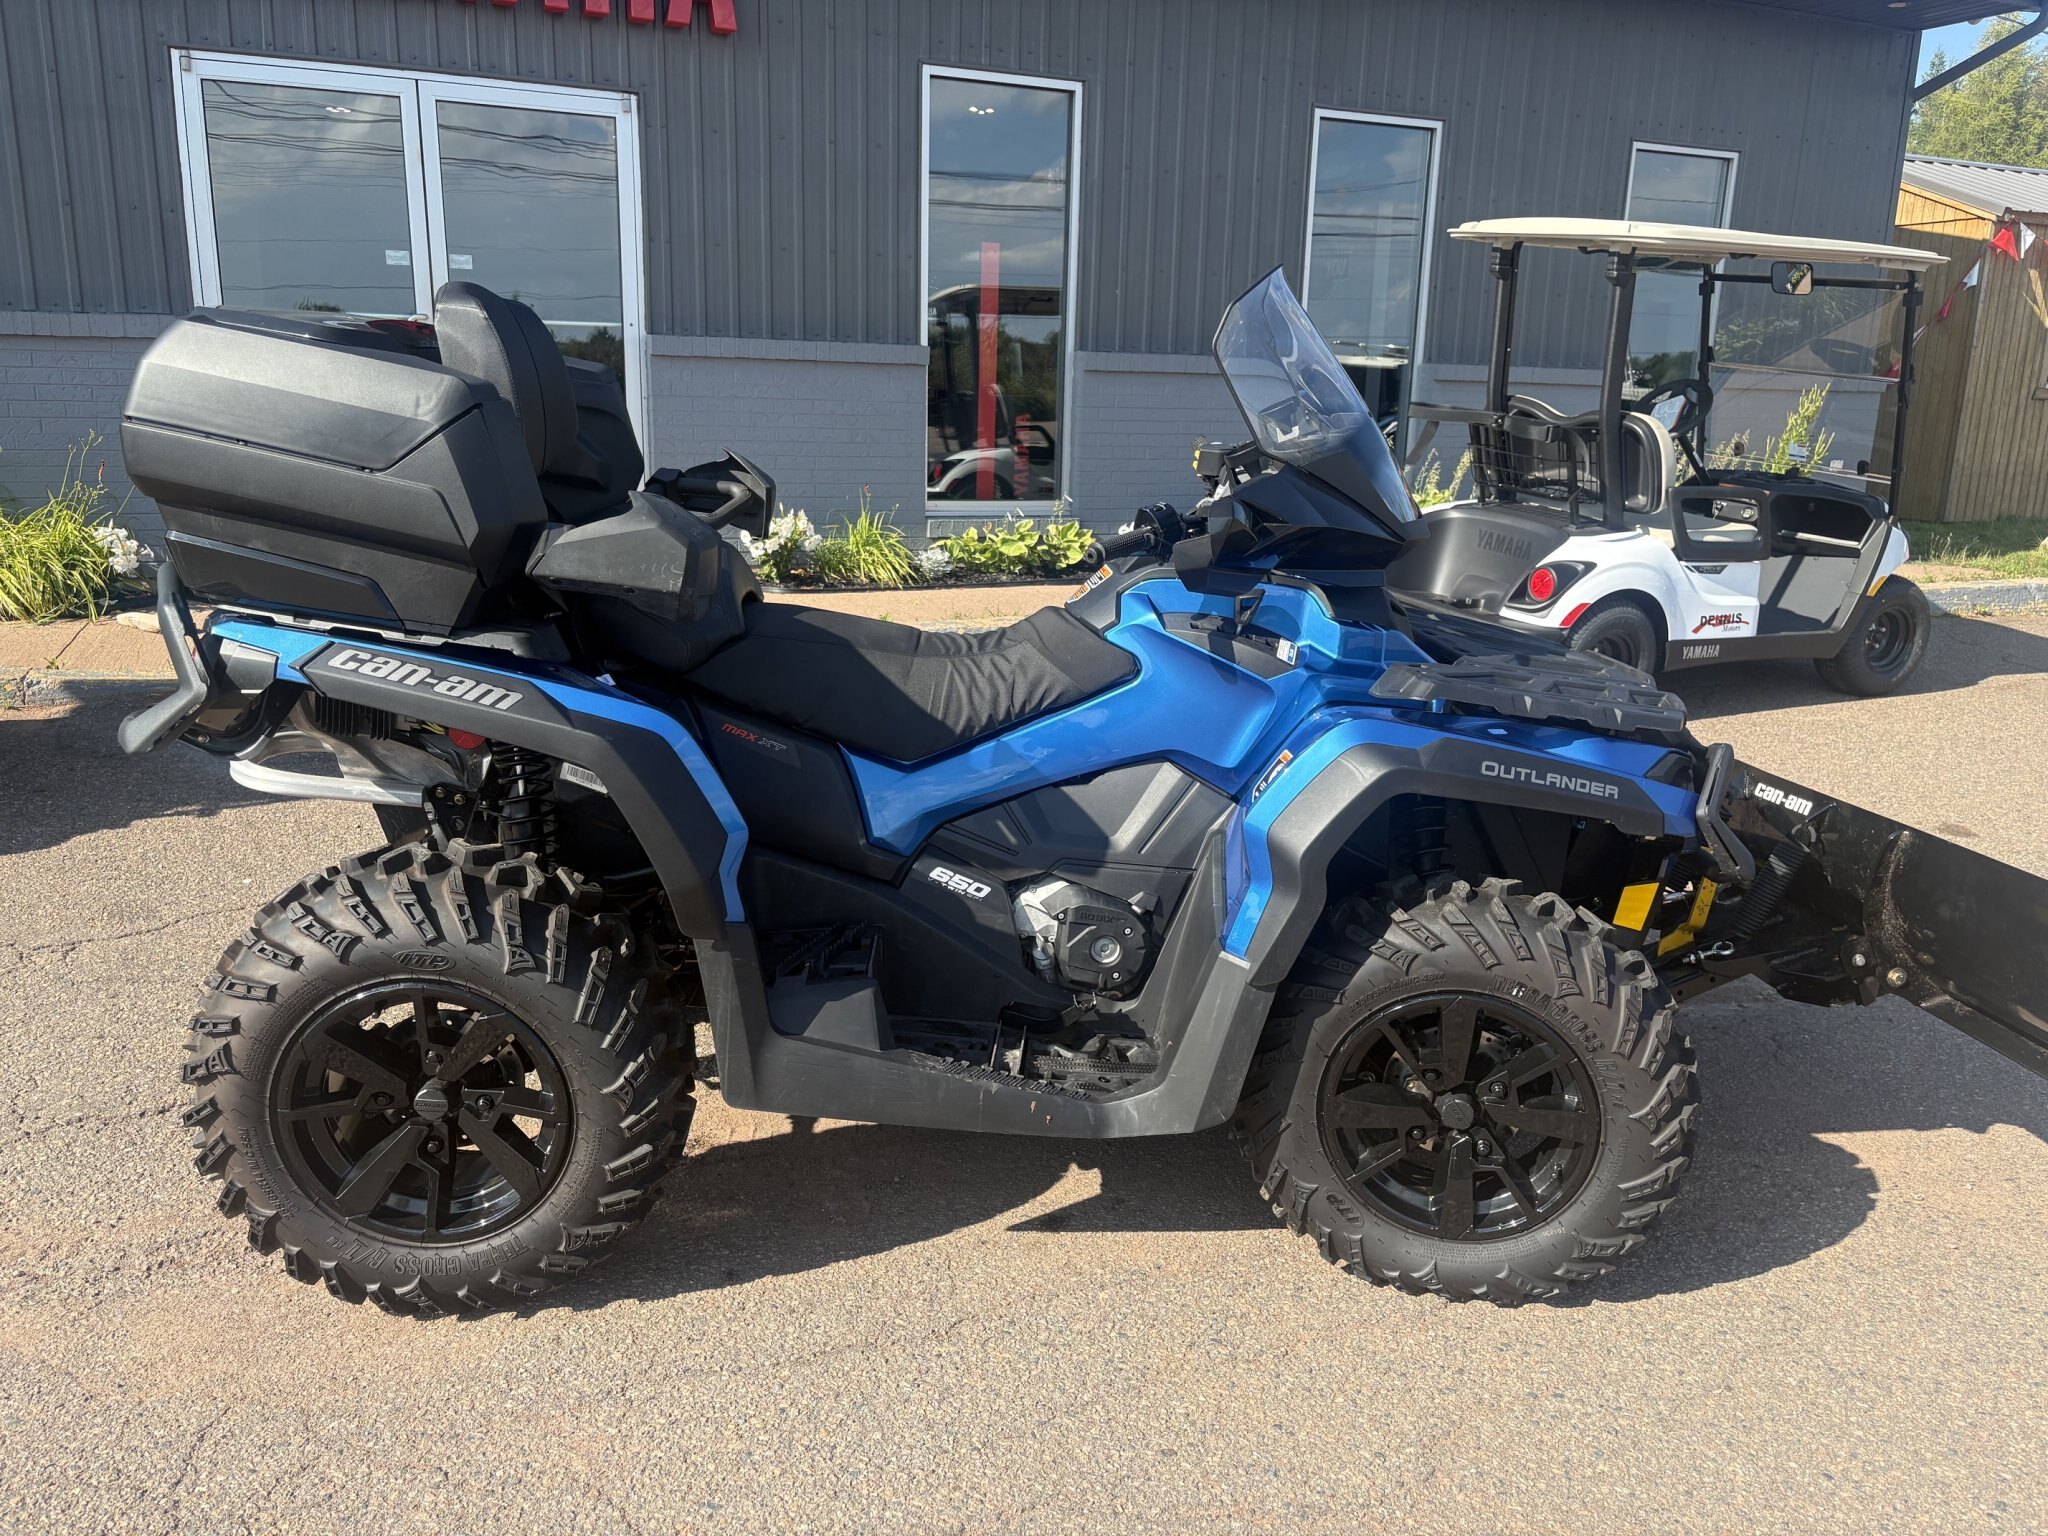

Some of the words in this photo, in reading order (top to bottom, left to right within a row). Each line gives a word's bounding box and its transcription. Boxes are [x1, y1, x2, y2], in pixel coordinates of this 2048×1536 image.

[1477, 528, 1532, 560] YAMAHA
[1700, 613, 1742, 626] DENNIS
[1682, 645, 1720, 659] YAMAHA
[327, 649, 524, 711] can-am
[721, 723, 758, 742] MAX
[757, 738, 787, 751] XT
[1480, 760, 1619, 799] OUTLANDER
[1754, 782, 1813, 816] can-am
[928, 866, 992, 898] 650
[398, 952, 450, 969] ITP
[1493, 974, 1552, 1012] TERRA
[1550, 1003, 1606, 1054] CROSS
[1325, 1194, 1361, 1225] ITP
[337, 1242, 391, 1270] R/T
[394, 1254, 462, 1276] CROSS
[466, 1233, 529, 1272] TERRA
